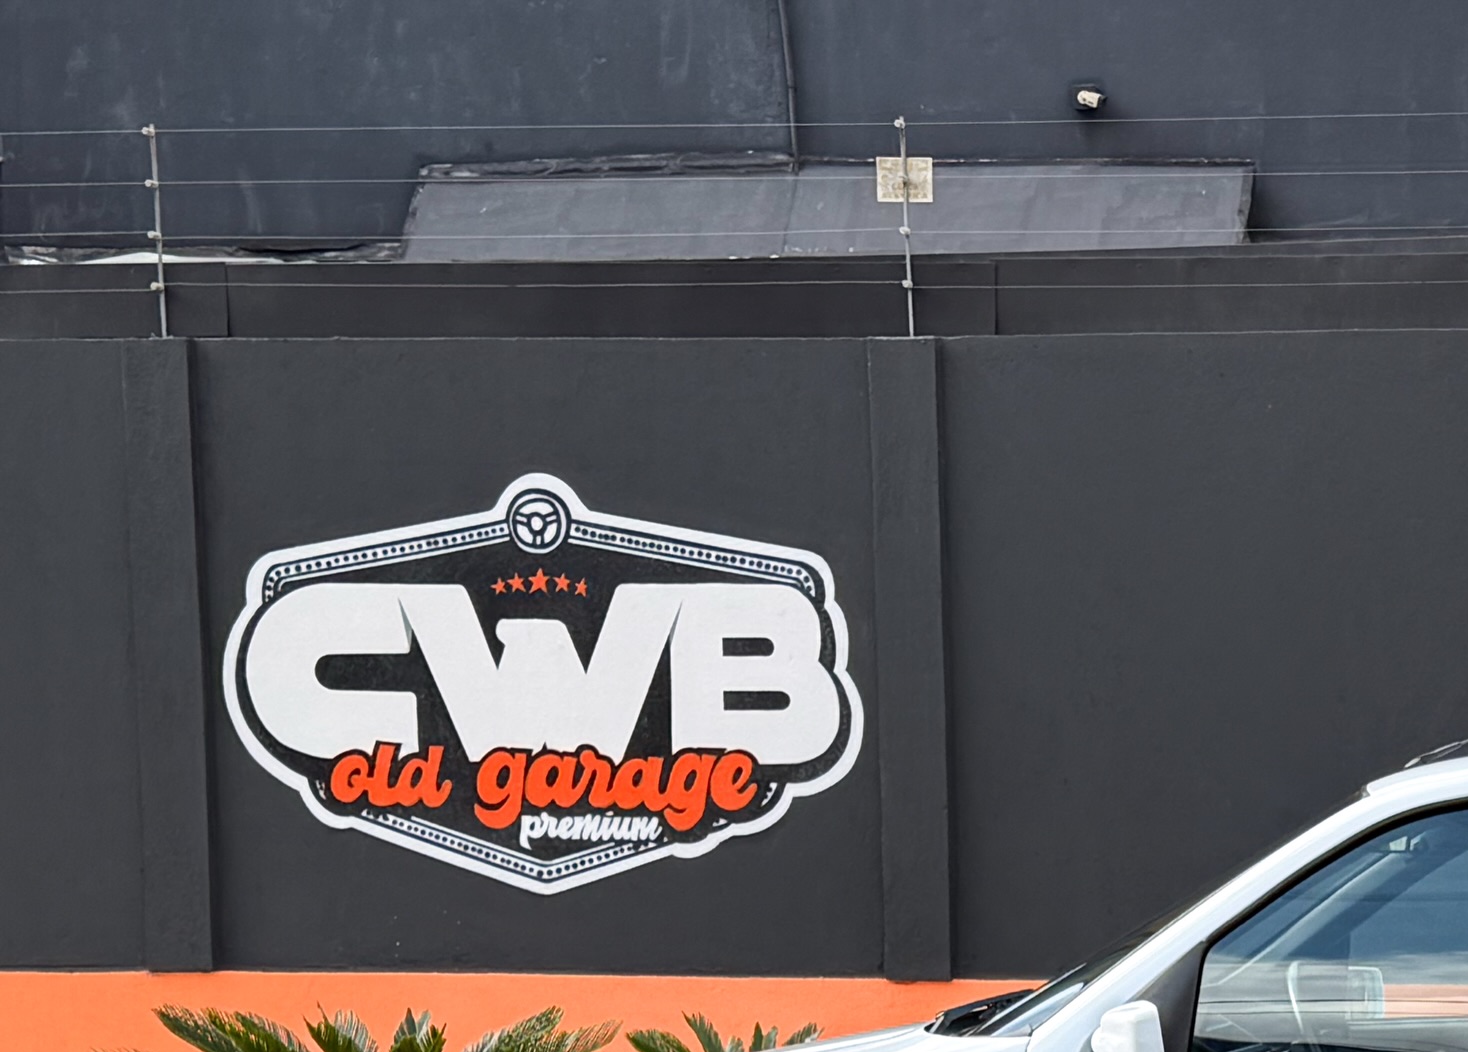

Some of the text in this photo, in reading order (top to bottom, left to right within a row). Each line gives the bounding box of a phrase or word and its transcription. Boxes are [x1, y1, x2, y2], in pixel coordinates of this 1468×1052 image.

[245, 582, 841, 764] CWB
[331, 744, 758, 831] old garage
[520, 811, 663, 850] premium
